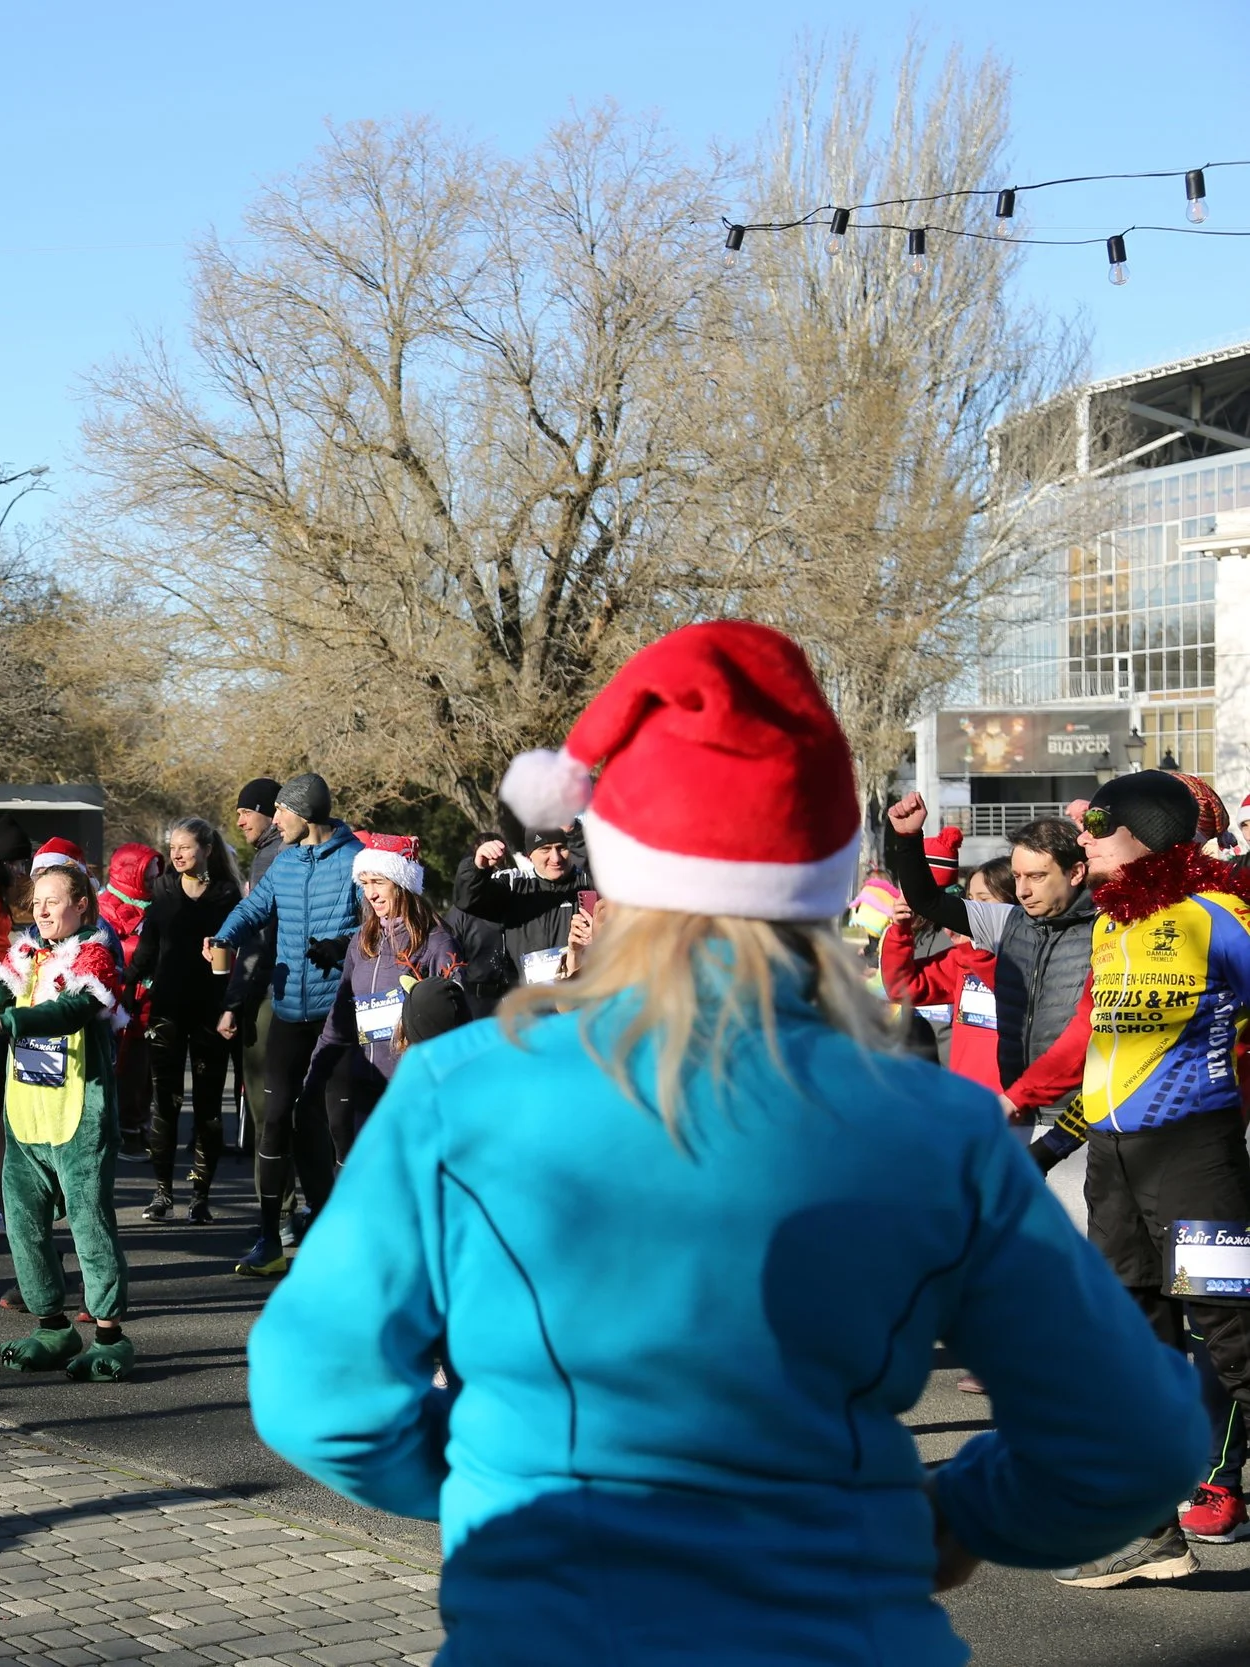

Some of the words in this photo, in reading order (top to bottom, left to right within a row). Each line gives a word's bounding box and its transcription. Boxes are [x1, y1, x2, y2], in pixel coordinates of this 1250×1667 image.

[1048, 741, 1073, 756] ВІД
[1075, 740, 1110, 754] УСІХ
[1145, 990, 1162, 1009] &
[1165, 990, 1195, 1008] ZN.
[1095, 1012, 1163, 1021] TREMELO
[1093, 1024, 1168, 1033] ARSCHOT
[1215, 1230, 1250, 1245] Бажа
